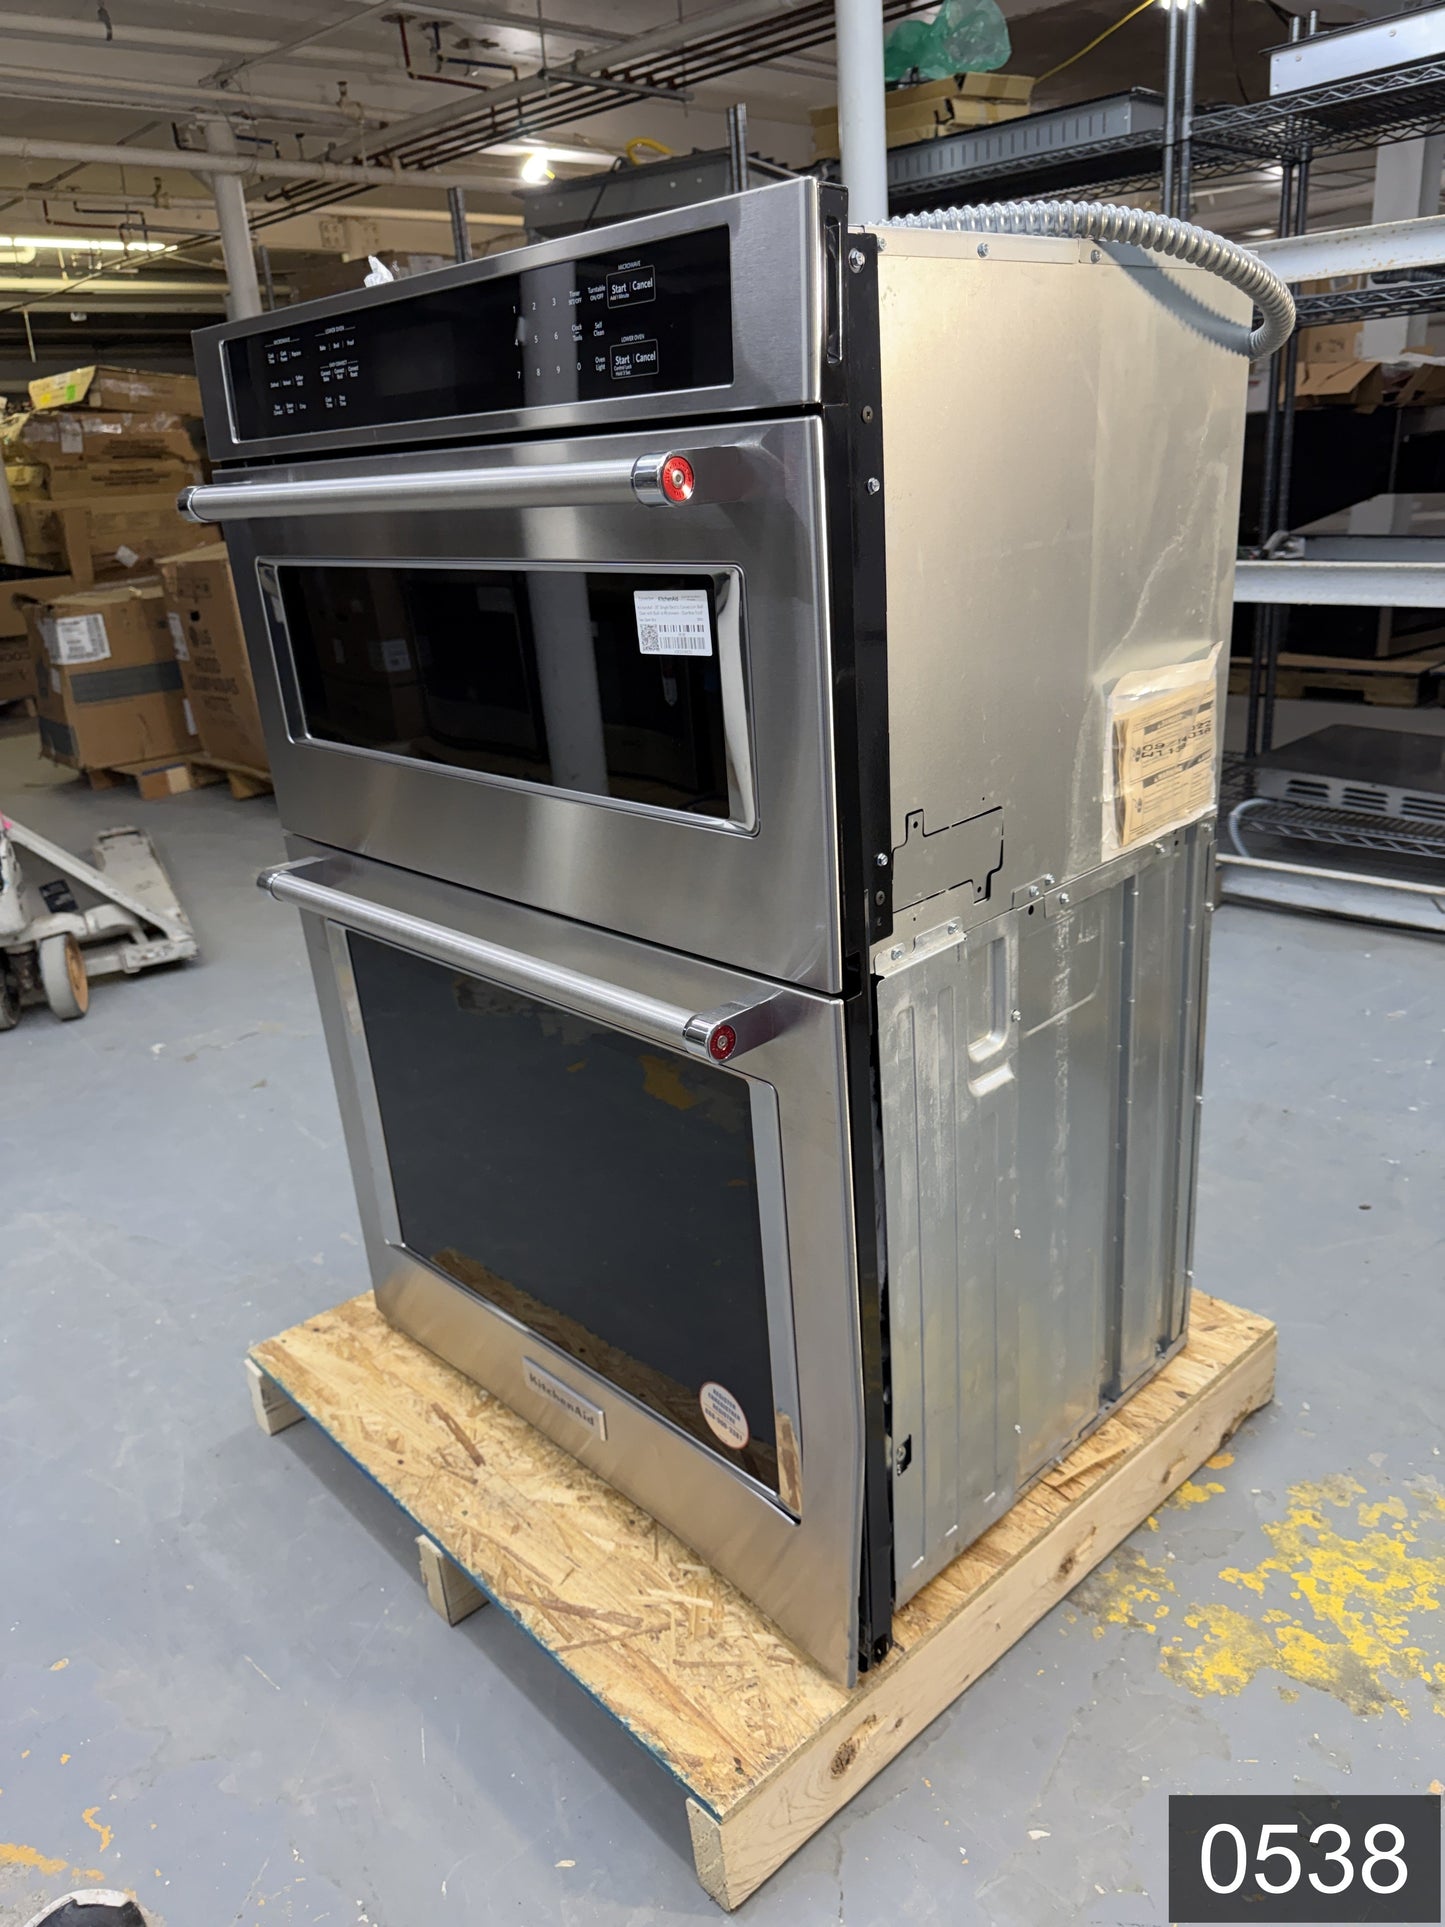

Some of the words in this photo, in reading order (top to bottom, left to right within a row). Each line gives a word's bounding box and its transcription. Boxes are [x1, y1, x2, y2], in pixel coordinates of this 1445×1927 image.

[587, 285, 605, 294] Turntable
[612, 284, 627, 294] Start
[632, 277, 653, 291] Cancel
[512, 306, 516, 314] 1
[532, 302, 536, 311] 2
[552, 298, 556, 306] 3
[572, 324, 582, 332] Clock
[514, 338, 519, 347] 4
[534, 335, 538, 344] 5
[554, 332, 558, 340] 6
[615, 355, 630, 365] Start
[636, 350, 656, 363] Cancel
[536, 368, 541, 376] 8
[556, 365, 561, 374] 9
[595, 362, 605, 372] Light
[529, 1372, 594, 1426] KitchenAid
